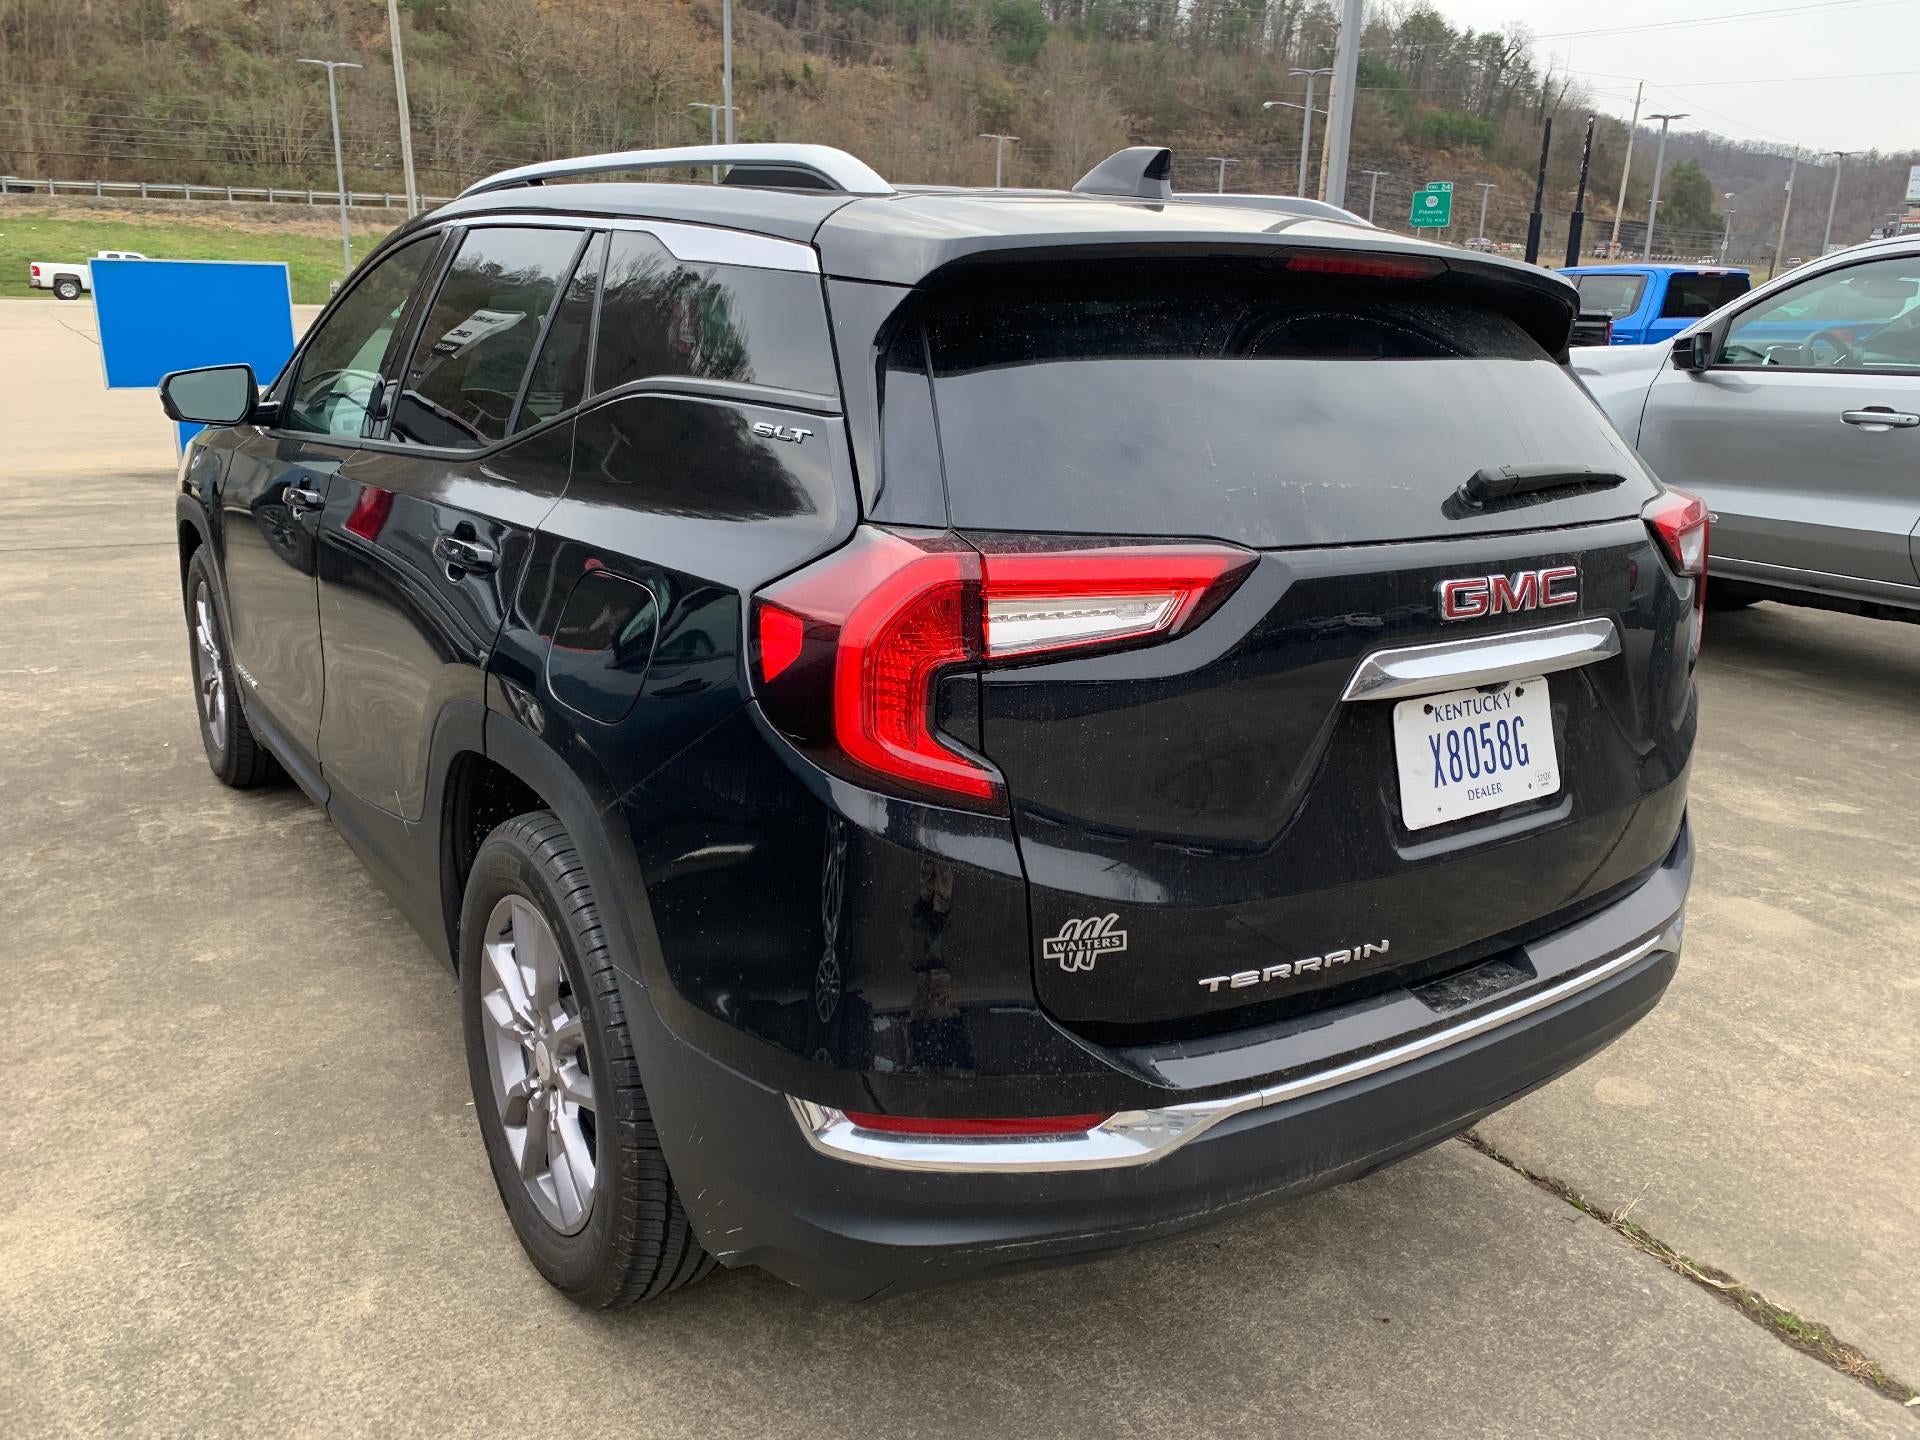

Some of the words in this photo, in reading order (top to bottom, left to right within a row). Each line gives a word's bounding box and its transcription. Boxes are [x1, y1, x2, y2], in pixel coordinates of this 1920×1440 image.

[752, 422, 814, 444] SLT
[1438, 566, 1578, 621] GMC
[1434, 691, 1512, 723] KENTUCKY
[1428, 715, 1530, 789] X8058G
[1467, 782, 1504, 801] DEALER
[1052, 937, 1120, 952] WALTERS
[1199, 939, 1390, 993] TERRAIN
